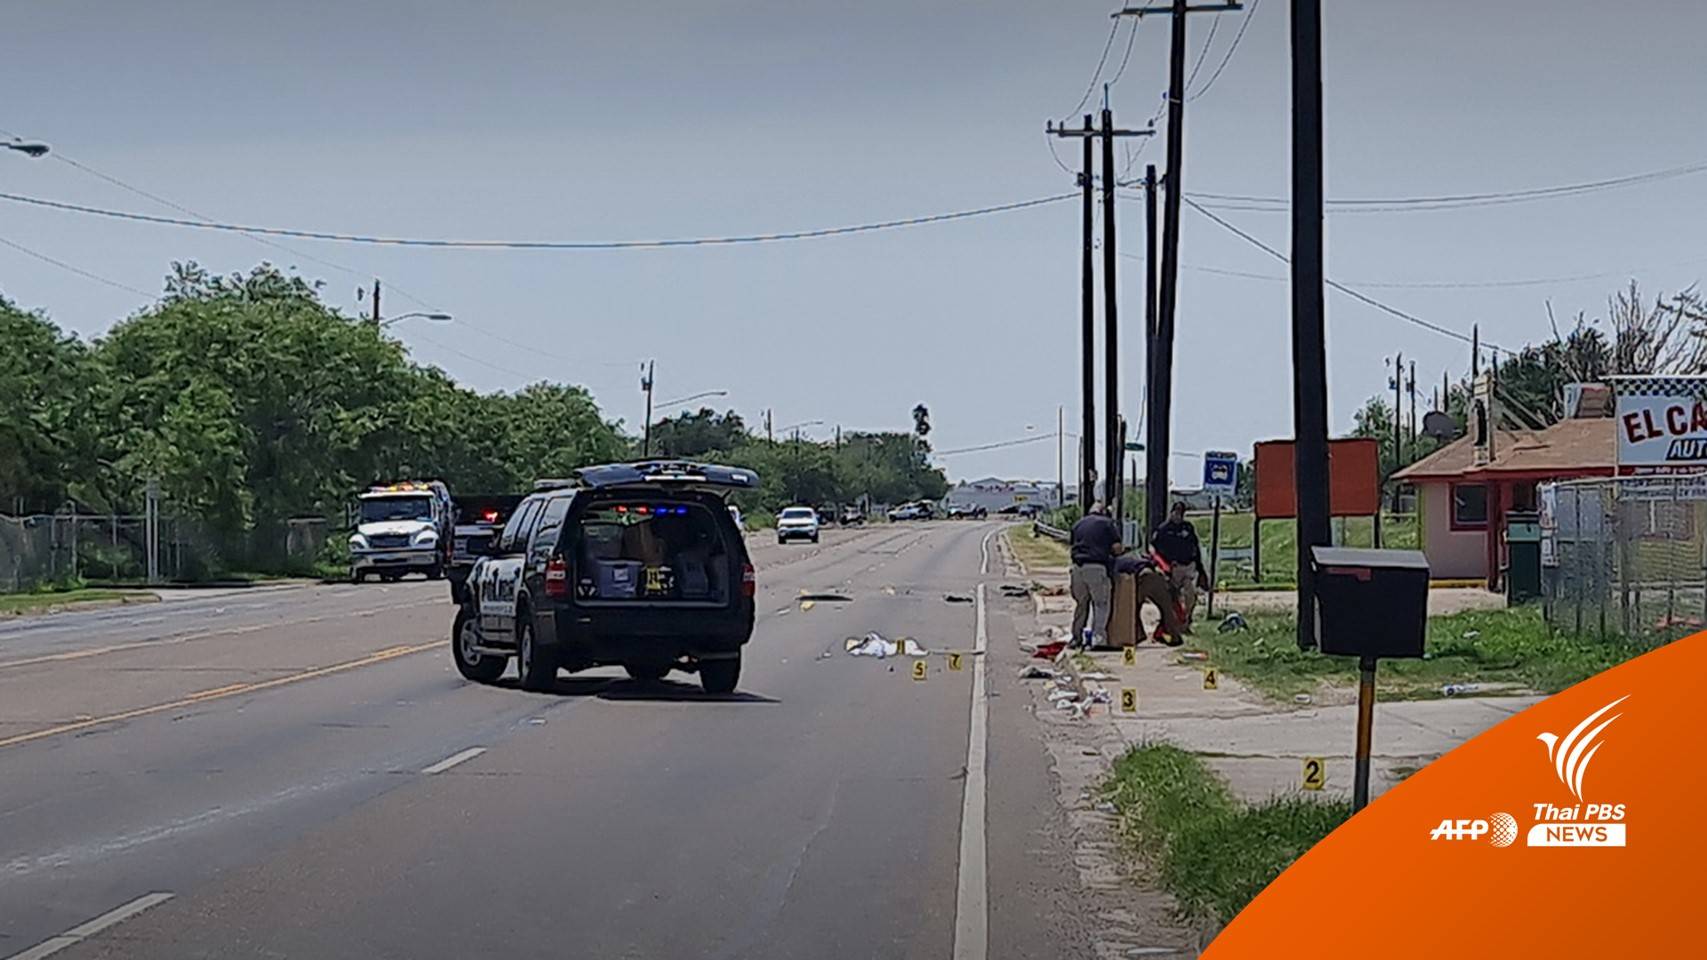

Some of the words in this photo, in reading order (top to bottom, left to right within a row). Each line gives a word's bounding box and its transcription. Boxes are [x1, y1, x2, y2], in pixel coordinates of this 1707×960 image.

[1622, 408, 1664, 444] EL
[1669, 439, 1707, 458] AUT
[914, 662, 924, 676] 5
[1205, 670, 1216, 685] 4
[1122, 691, 1133, 707] 3
[1305, 760, 1320, 783] 2
